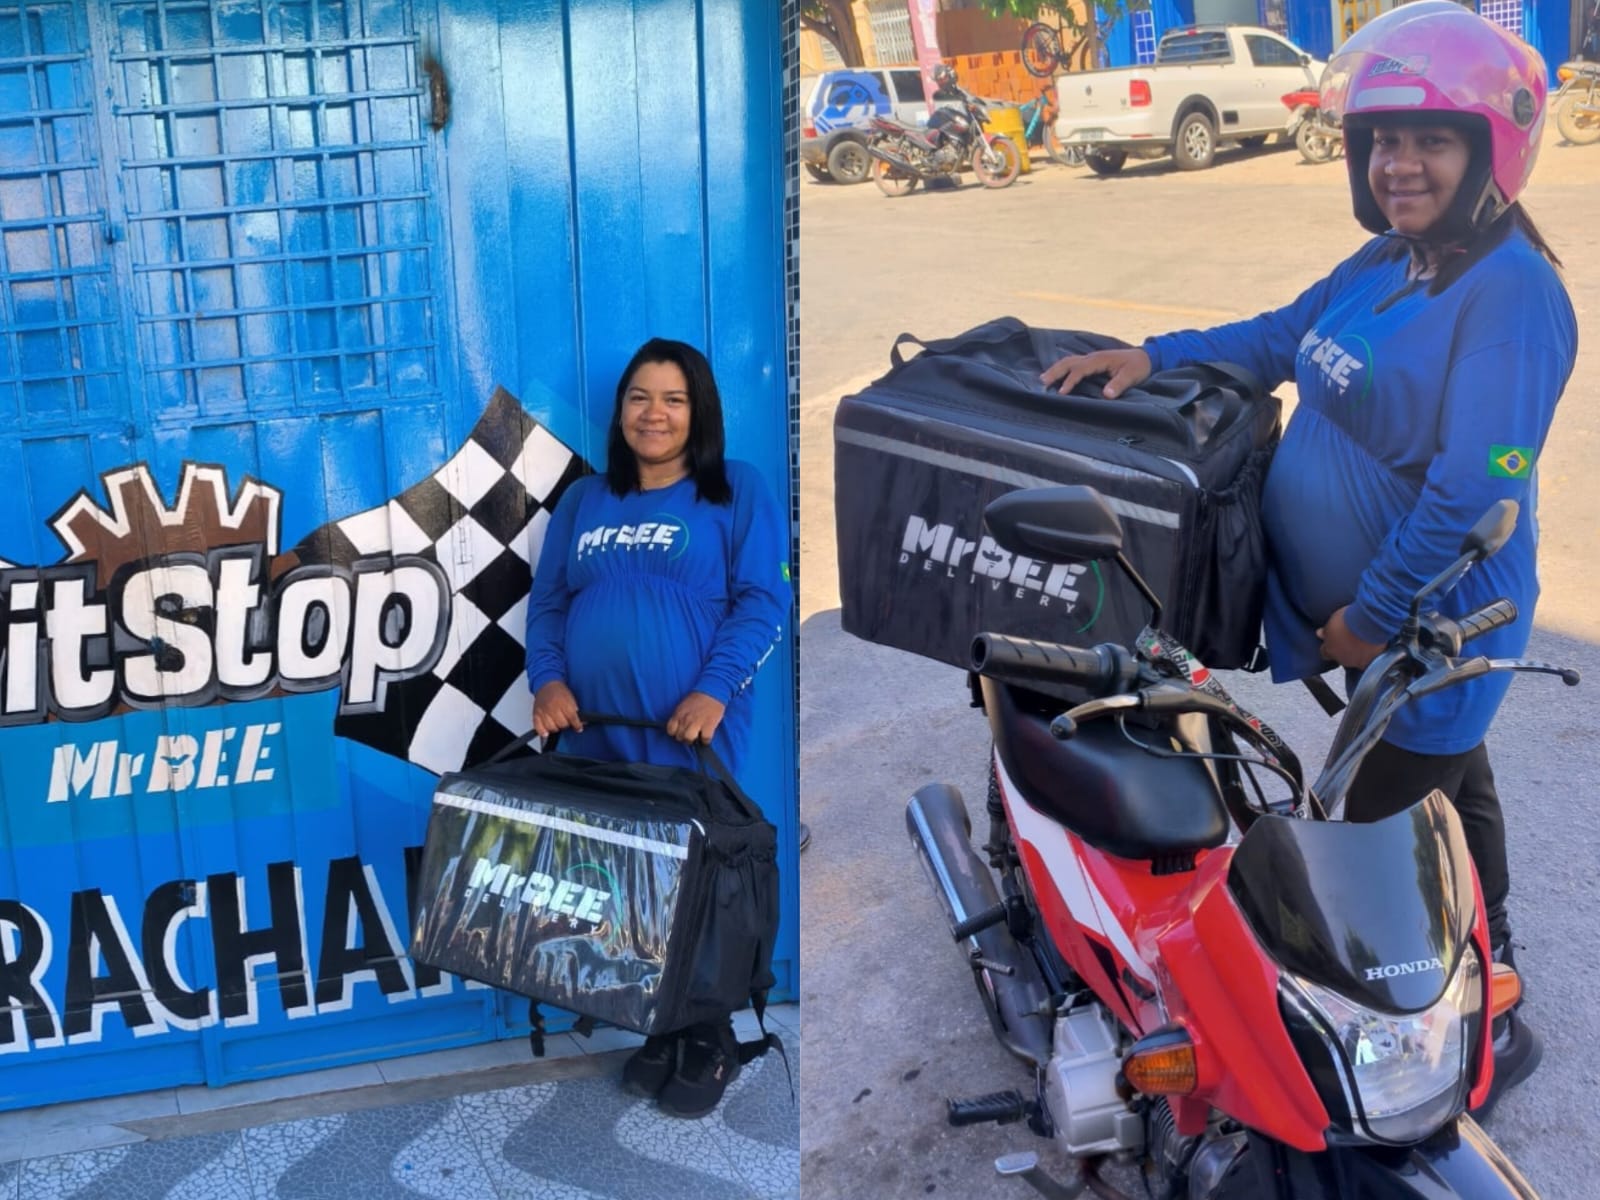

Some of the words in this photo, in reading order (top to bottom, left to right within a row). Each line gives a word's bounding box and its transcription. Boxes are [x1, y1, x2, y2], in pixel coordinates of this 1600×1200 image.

[578, 522, 680, 553] MrBEE
[903, 515, 1087, 601] MrBEE
[899, 553, 1076, 614] DELIVERY
[0, 558, 437, 713] itStop
[47, 722, 281, 803] MrBEE
[469, 858, 610, 924] MrBEE
[1365, 957, 1445, 981] HONDA
